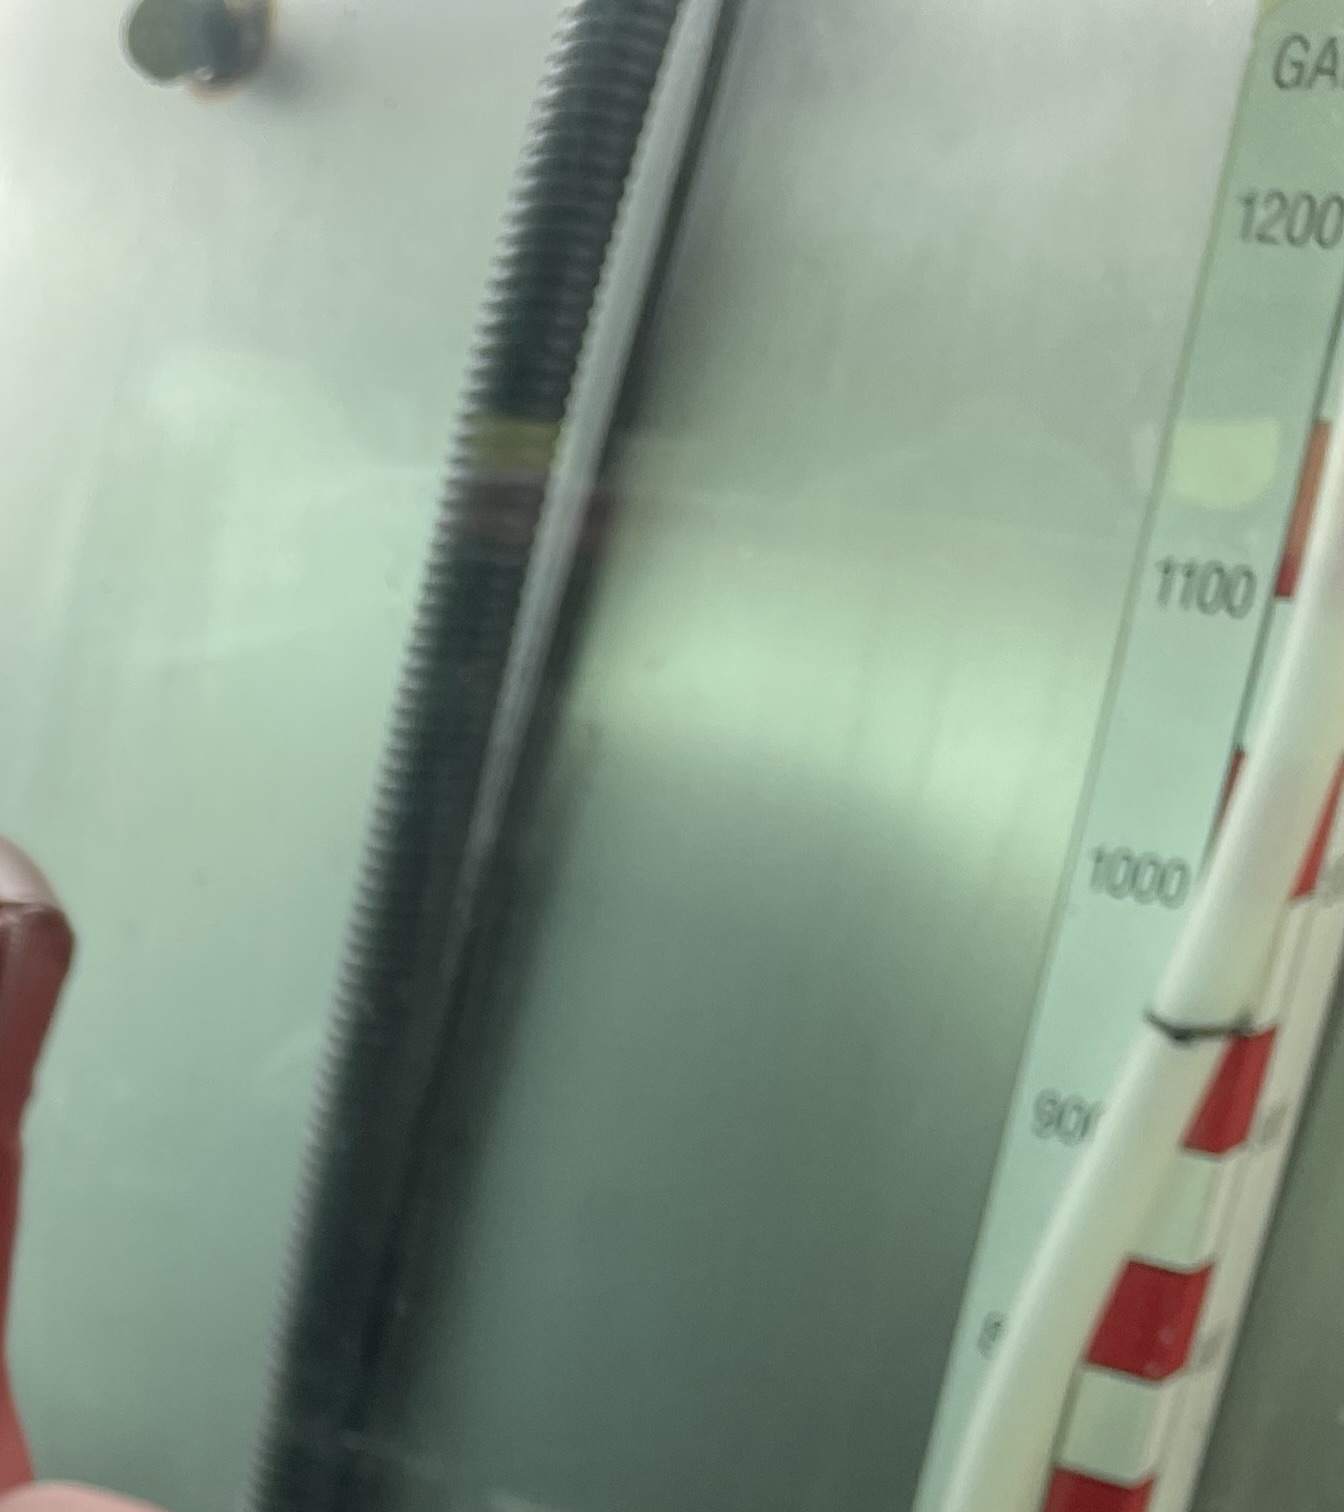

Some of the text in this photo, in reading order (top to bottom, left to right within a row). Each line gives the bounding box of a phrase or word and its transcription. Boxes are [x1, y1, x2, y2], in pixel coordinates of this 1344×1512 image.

[1273, 32, 1344, 90] GA
[1239, 188, 1344, 249] 1200
[1155, 554, 1258, 620] 1100
[1088, 844, 1190, 911] 1000
